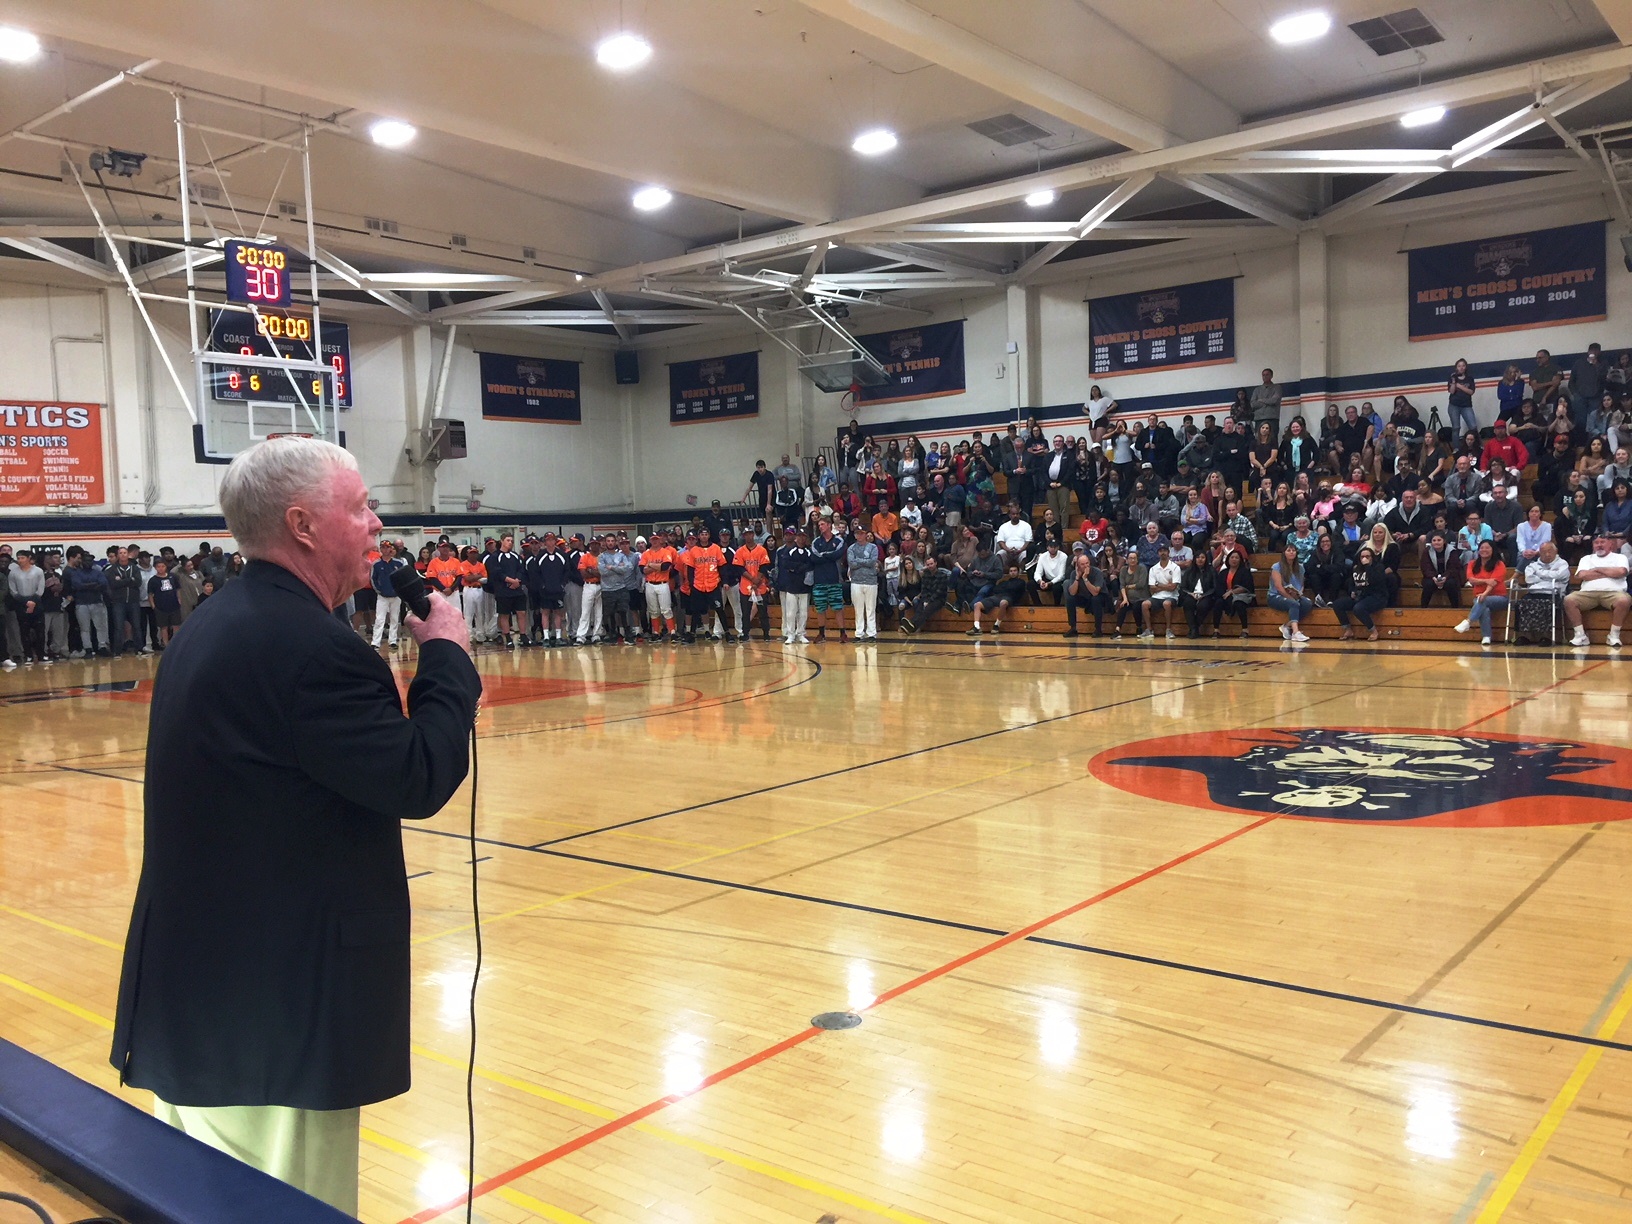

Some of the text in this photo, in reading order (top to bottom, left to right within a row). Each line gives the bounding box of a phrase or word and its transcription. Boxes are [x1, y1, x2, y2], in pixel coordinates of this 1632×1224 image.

[236, 246, 286, 269] 20:00
[246, 266, 279, 299] 30
[1417, 268, 1597, 304] MEN'S CROSS COUNTRY
[1508, 295, 1536, 307] 2003
[1548, 290, 1576, 301] 2004
[1093, 318, 1229, 346] WOMEN'S CROSS COUNTRY
[223, 333, 250, 345] COAST
[320, 345, 341, 354] UEST
[904, 357, 941, 372] TENNIS
[229, 373, 239, 389] 0
[249, 374, 260, 391] 6
[223, 390, 242, 399] SCORE
[21, 436, 68, 448] SPORTS
[42, 448, 69, 456] SOCCER
[42, 457, 80, 465] SWIMMING
[42, 465, 70, 473] TENNIS
[7, 475, 41, 484] COUNTRY
[44, 475, 68, 483] TRACK
[74, 475, 95, 483] FIELD
[44, 483, 88, 492] VOLLEYBALL
[45, 492, 89, 500] WATER POLO
